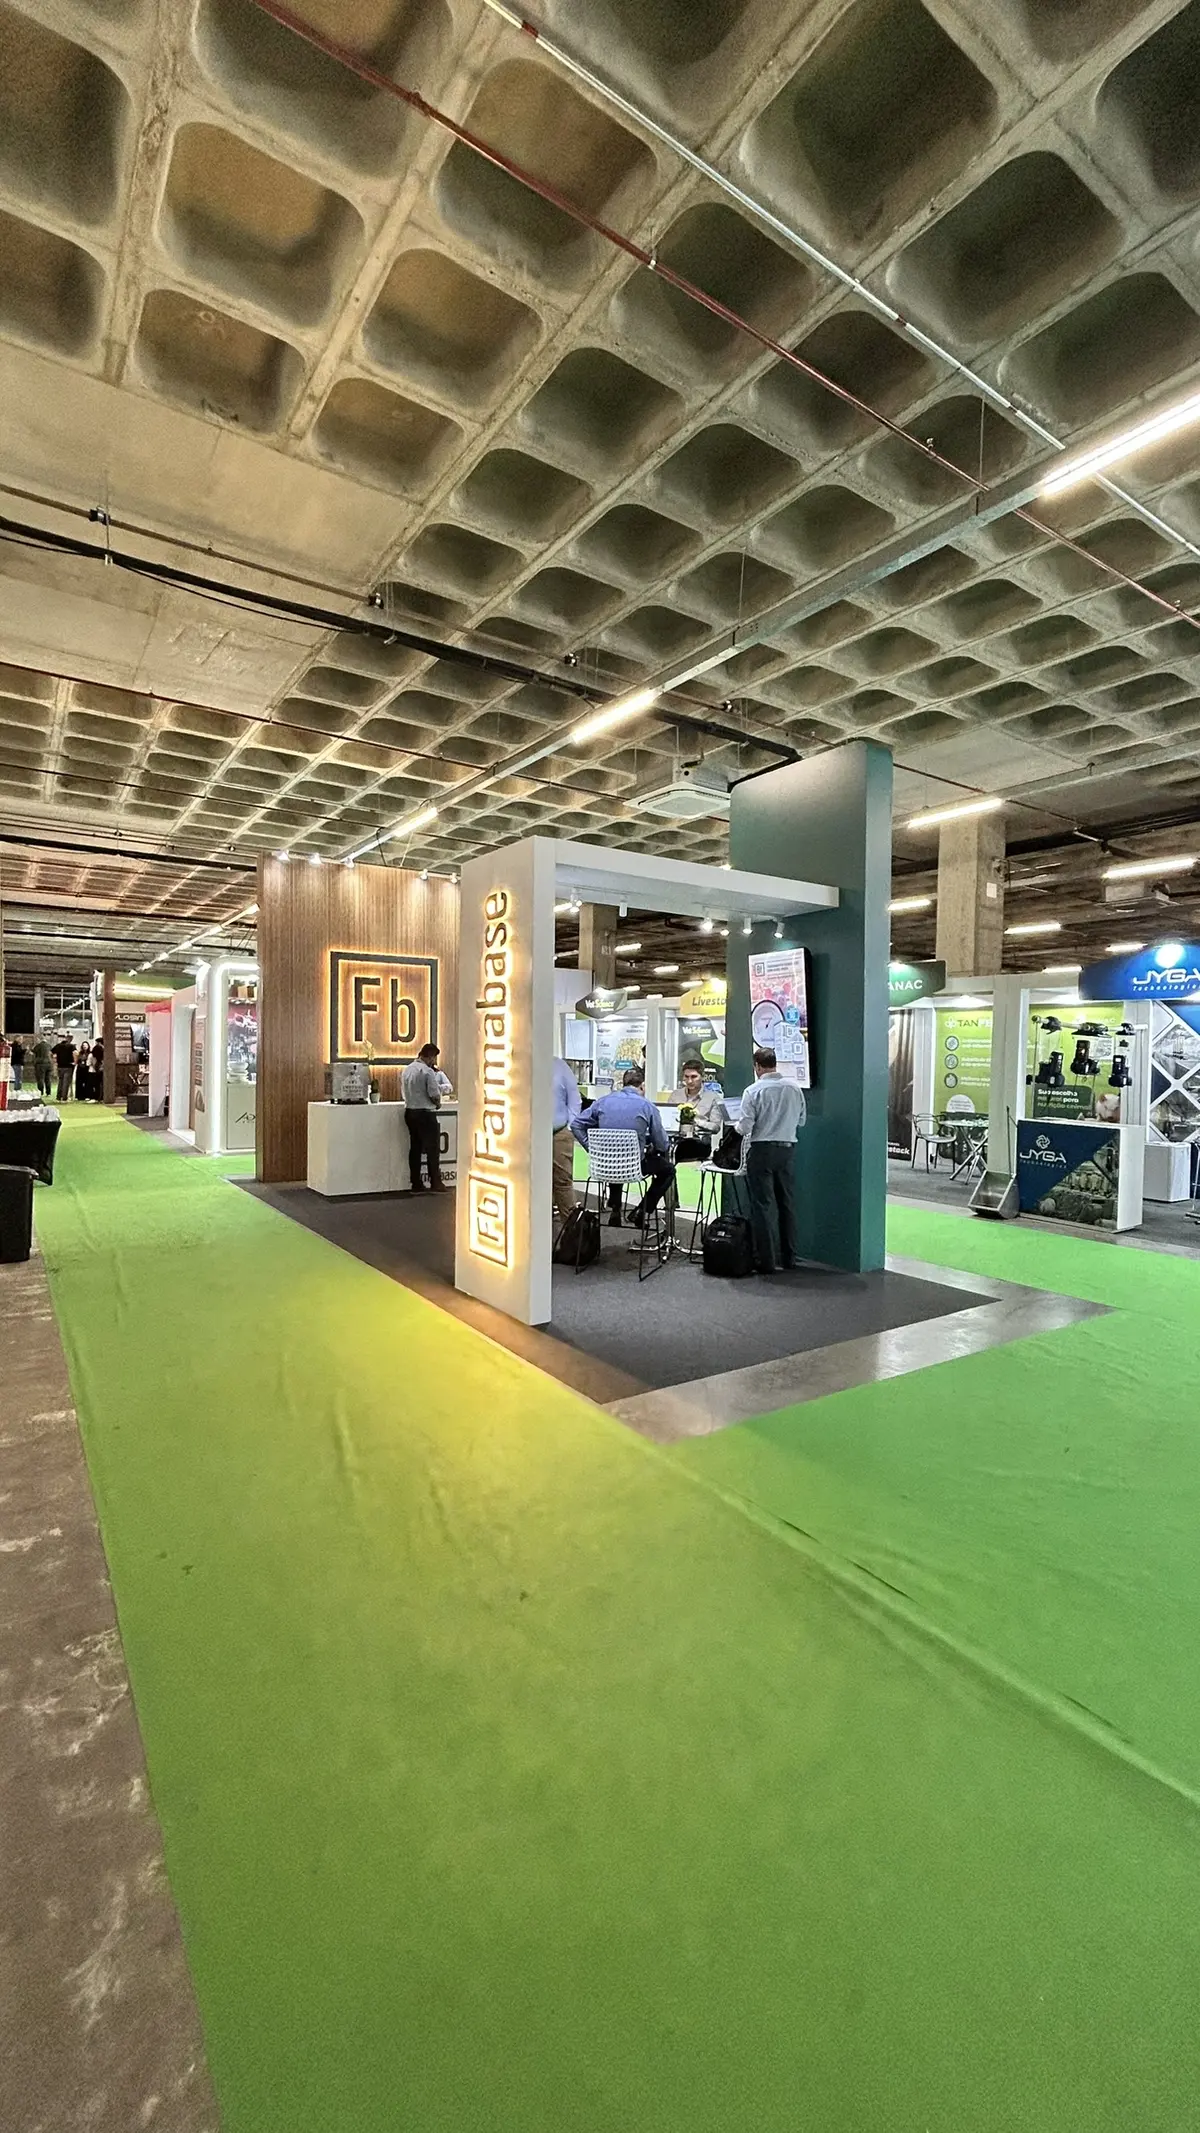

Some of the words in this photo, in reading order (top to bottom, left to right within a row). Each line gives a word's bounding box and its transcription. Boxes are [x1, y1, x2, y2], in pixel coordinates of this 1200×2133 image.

[1132, 967, 1200, 985] JYGA
[888, 979, 923, 991] ANAC
[691, 995, 726, 1007] Livesto
[353, 976, 417, 1043] Fb
[475, 891, 508, 1164] Farmabase
[957, 1018, 993, 1028] TANFE
[888, 1147, 910, 1156] stock
[1019, 1148, 1067, 1164] JYGA
[477, 1197, 500, 1243] Fb
